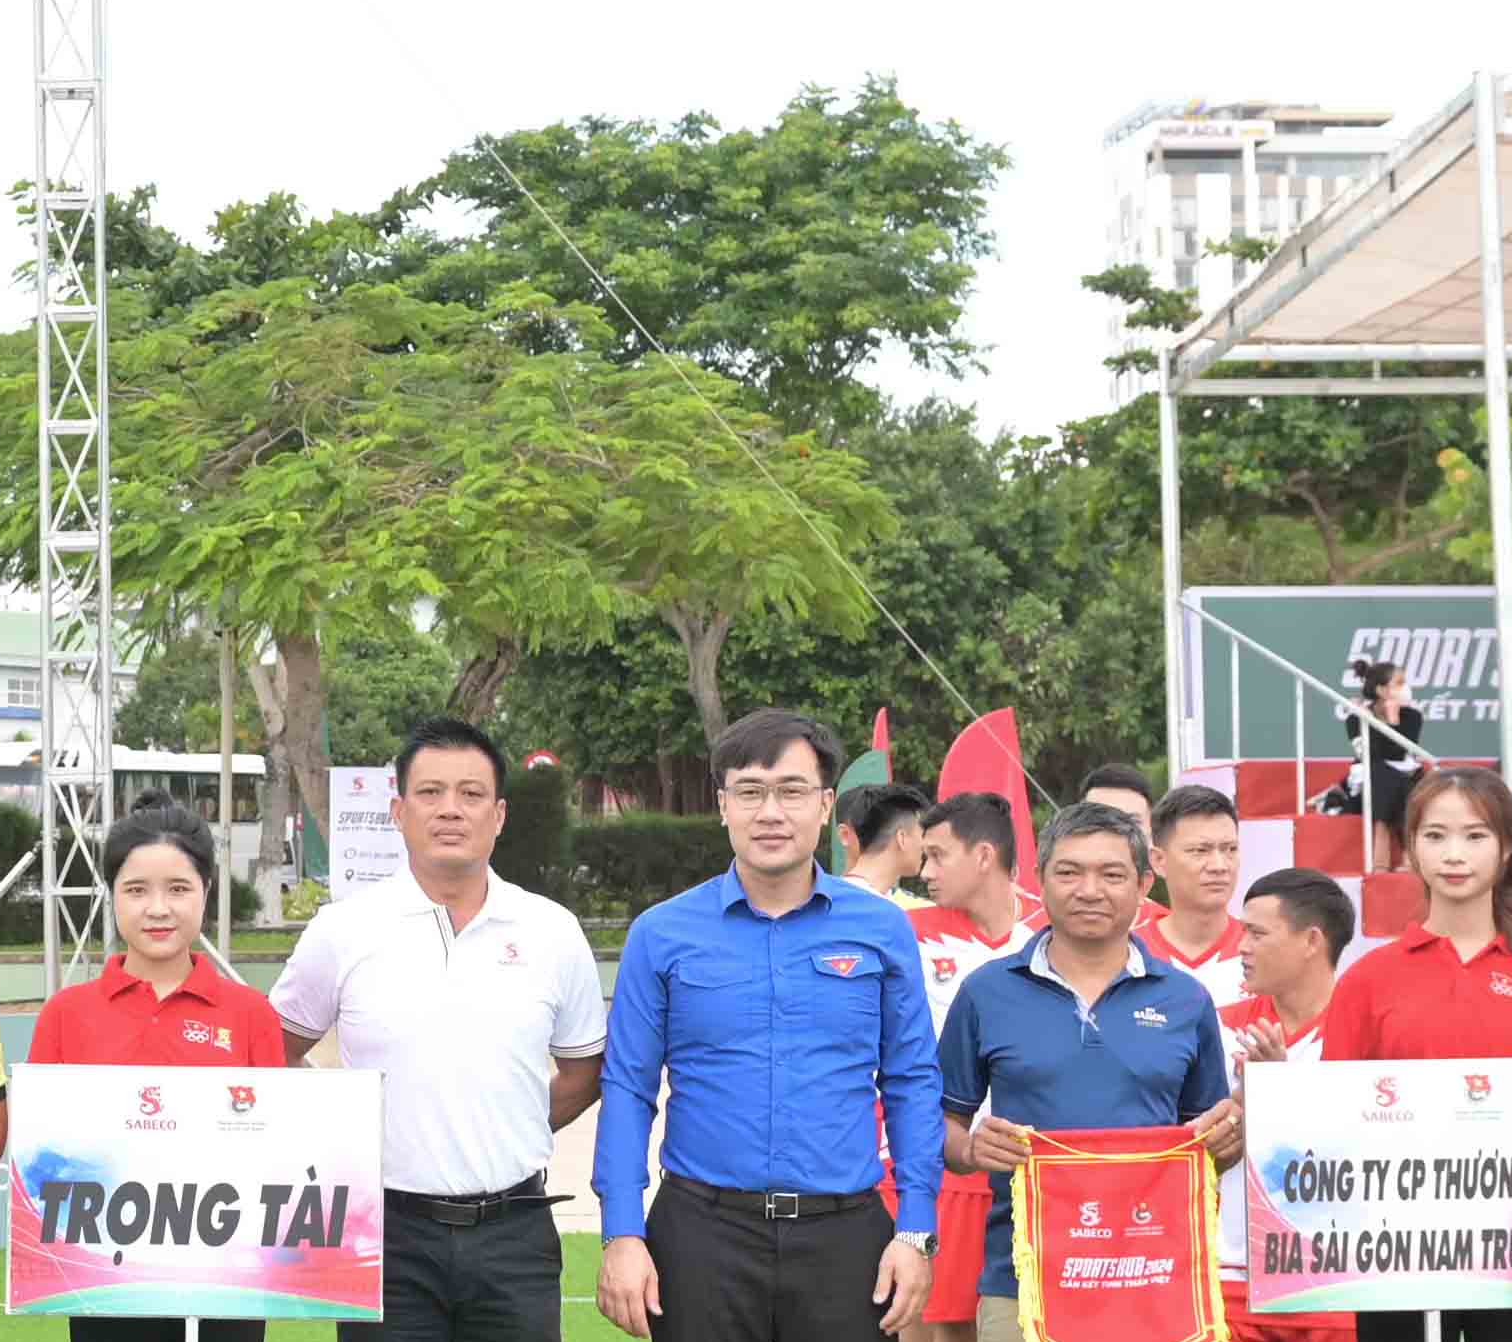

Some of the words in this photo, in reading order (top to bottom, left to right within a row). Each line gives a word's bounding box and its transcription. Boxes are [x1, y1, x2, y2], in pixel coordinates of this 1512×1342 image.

[125, 1118, 177, 1130] SABECO
[1284, 1148, 1355, 1203] CÔNG
[1362, 1159, 1391, 1201] TY
[1397, 1158, 1427, 1201] CP
[39, 1180, 242, 1266] TRỌNG
[260, 1164, 350, 1248] TÀI
[1263, 1231, 1304, 1275] BIA
[1310, 1219, 1349, 1274] SÀI
[1356, 1218, 1412, 1274] GÒN
[1418, 1228, 1474, 1272] NAM
